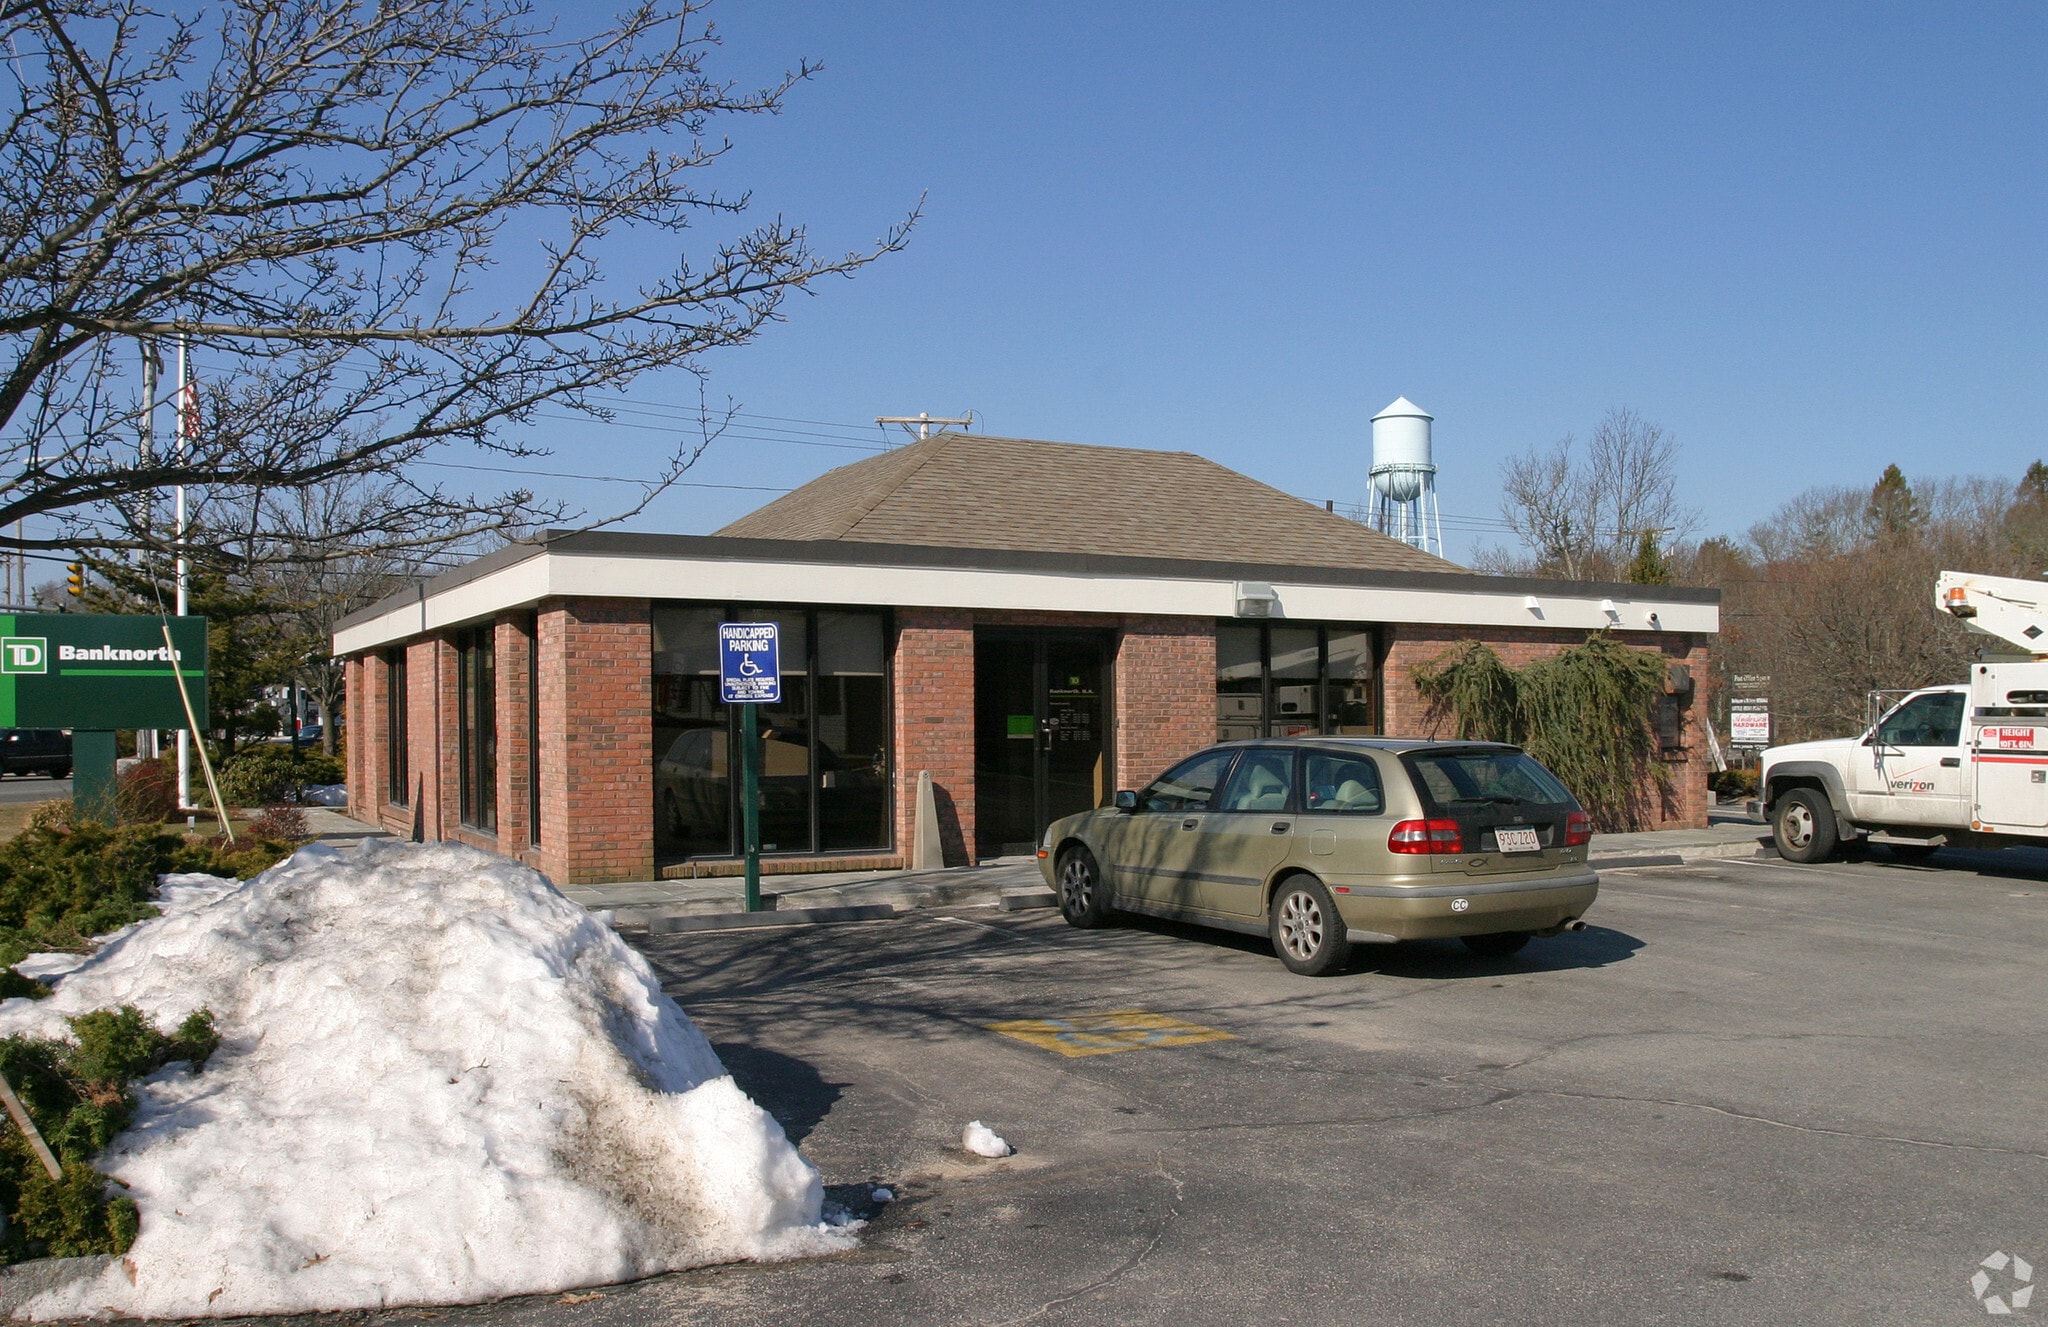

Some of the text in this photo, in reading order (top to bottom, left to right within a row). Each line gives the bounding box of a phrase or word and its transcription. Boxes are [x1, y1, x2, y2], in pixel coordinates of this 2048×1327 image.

[723, 627, 774, 639] HANDICAPPED
[729, 640, 769, 651] PARKING
[6, 644, 181, 666] TD Banknorth
[2002, 729, 2030, 737] HEIGHT
[1890, 779, 1935, 792] verizon
